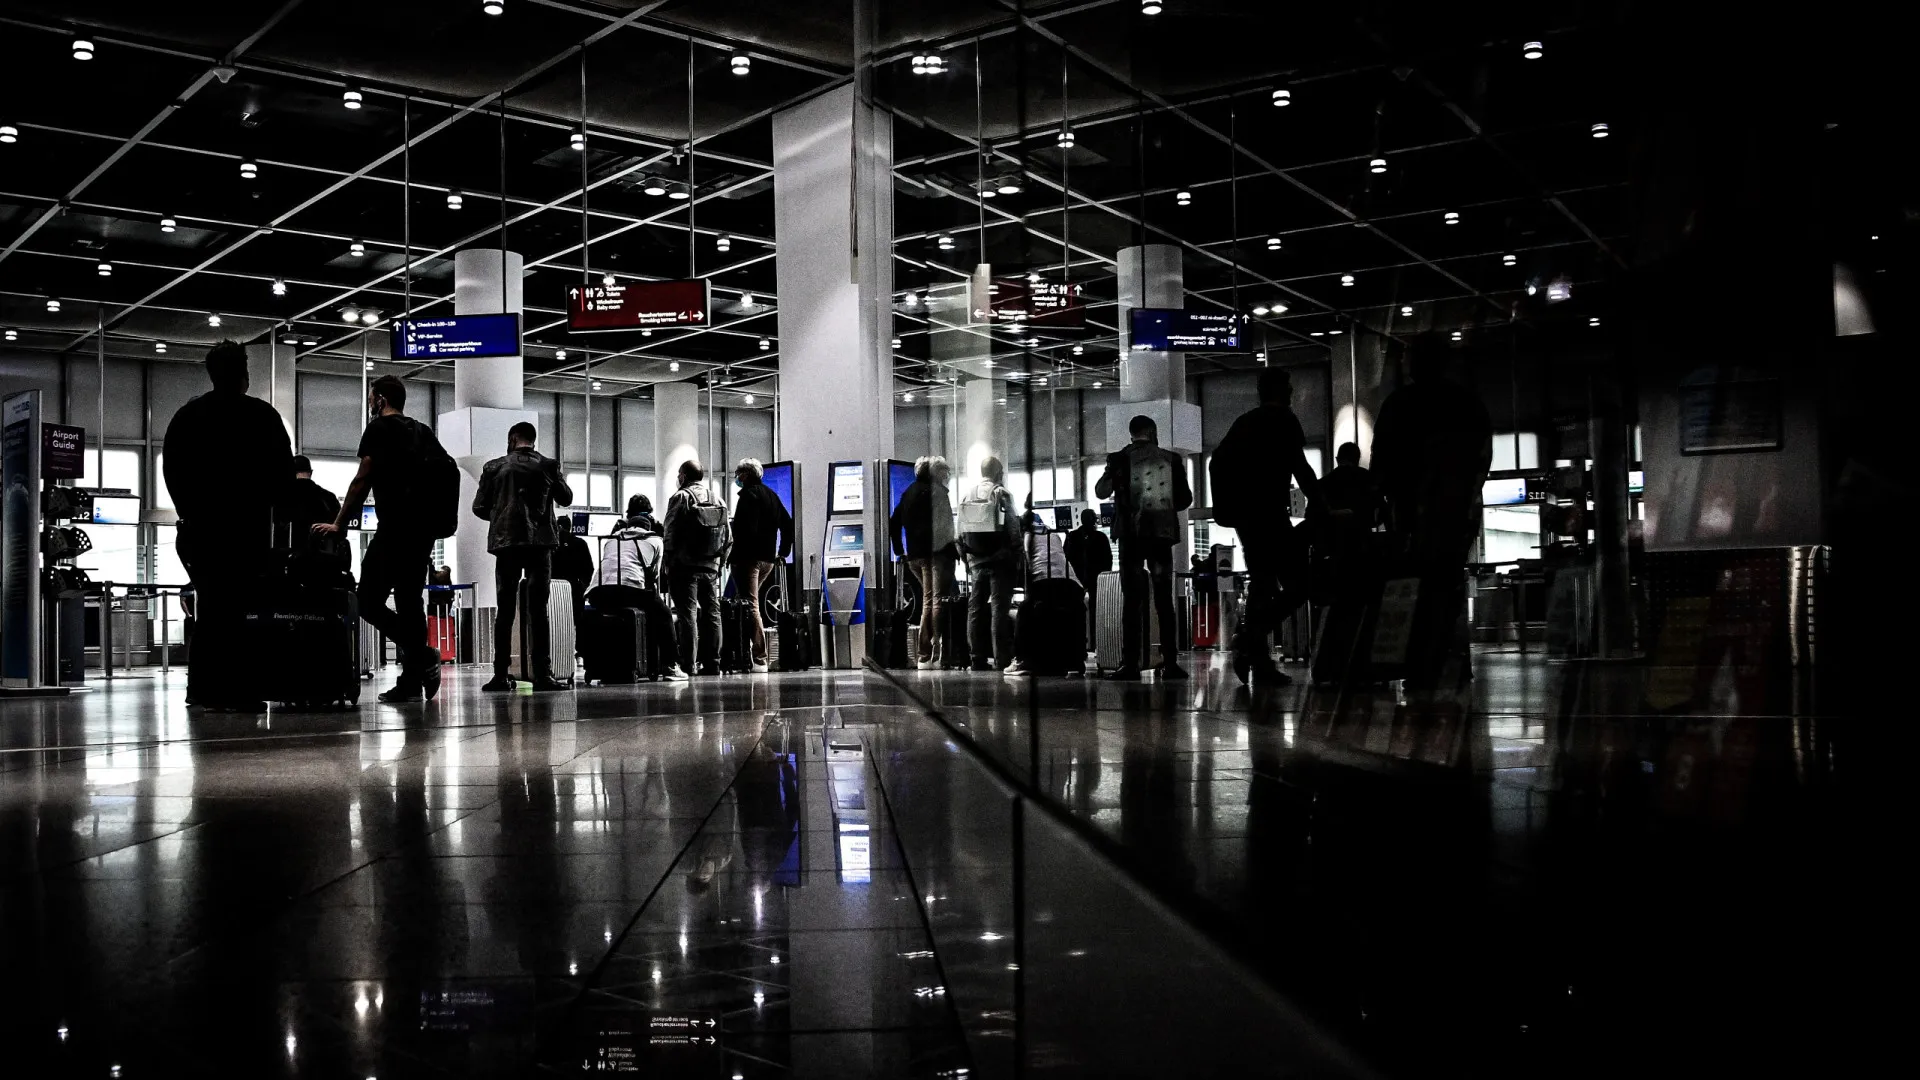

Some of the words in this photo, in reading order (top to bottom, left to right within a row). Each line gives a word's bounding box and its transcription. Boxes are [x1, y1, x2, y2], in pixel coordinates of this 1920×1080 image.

[52, 430, 79, 441] Airport
[52, 440, 75, 450] Guide
[72, 511, 90, 520] 12
